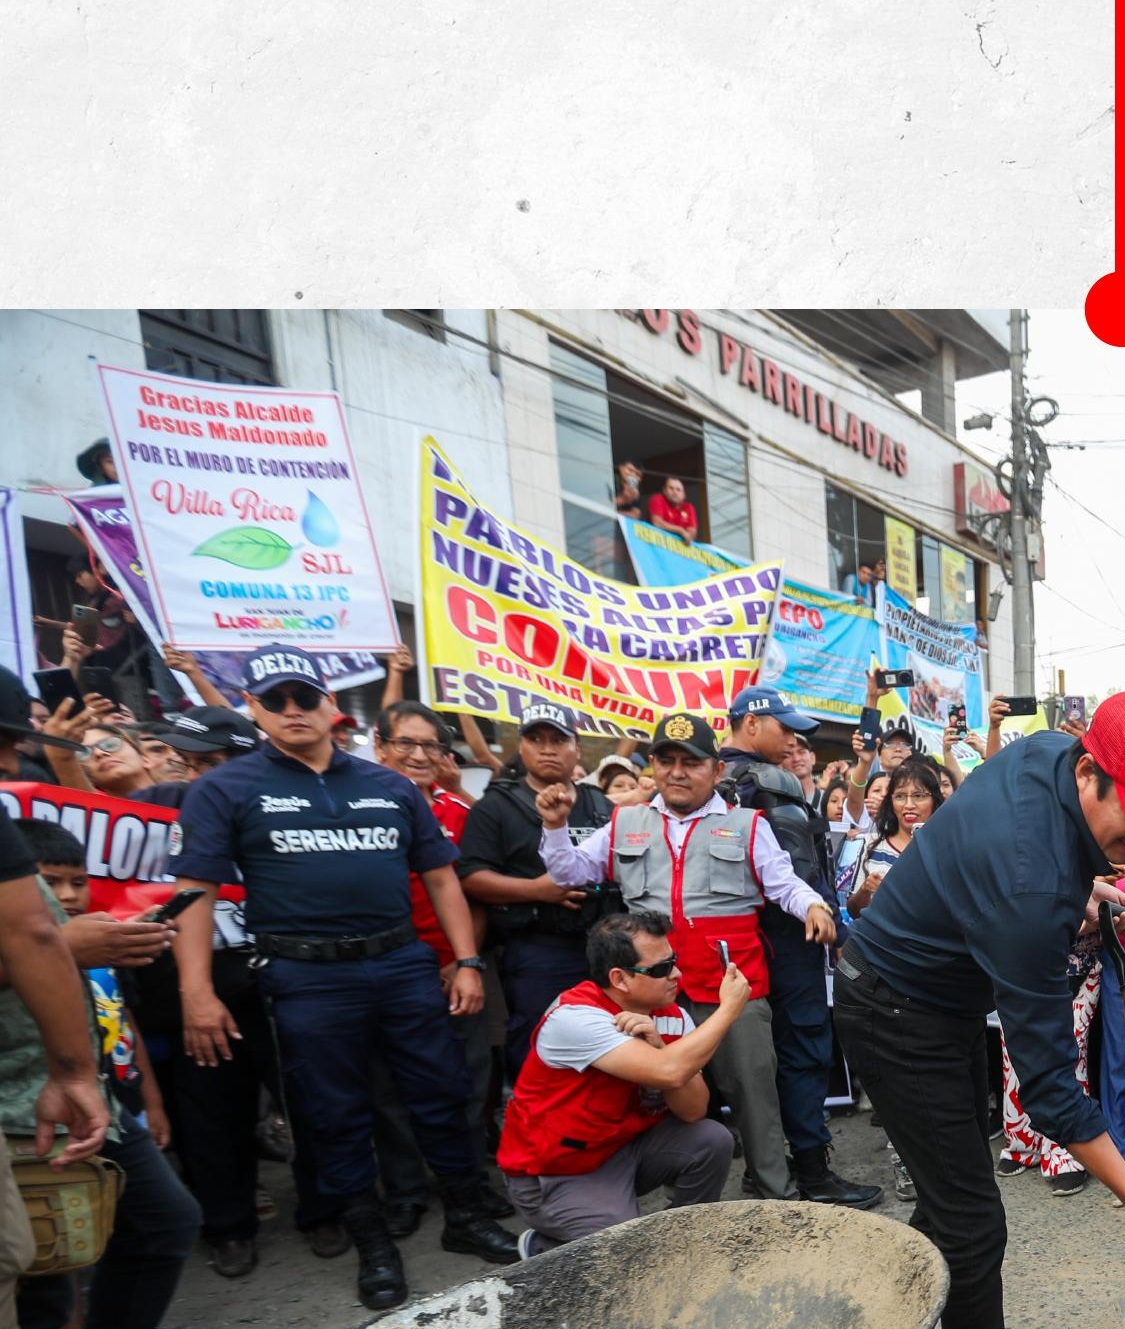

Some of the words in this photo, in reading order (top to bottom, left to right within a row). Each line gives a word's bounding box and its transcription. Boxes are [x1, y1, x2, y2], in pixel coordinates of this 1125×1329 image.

[139, 384, 230, 418] Gracias
[234, 400, 315, 424] Alcalde
[718, 331, 909, 478] PARRILLADAS
[137, 409, 204, 437] Jesus
[207, 421, 328, 448] Maldonado
[127, 441, 163, 465] POR
[165, 447, 185, 467] EL
[184, 450, 233, 474] MURO
[234, 457, 256, 475] DE
[151, 479, 227, 516] Villa
[229, 487, 298, 524] Rica
[302, 552, 353, 575] SJL
[200, 580, 289, 600] COMUNA
[603, 607, 734, 636] ALTAS
[250, 653, 319, 682] DELTA
[477, 650, 532, 681] POR
[537, 673, 585, 703] UNA
[591, 694, 655, 724] VIDA
[522, 703, 567, 727] DELTA
[270, 827, 399, 853] SERENAZGO
